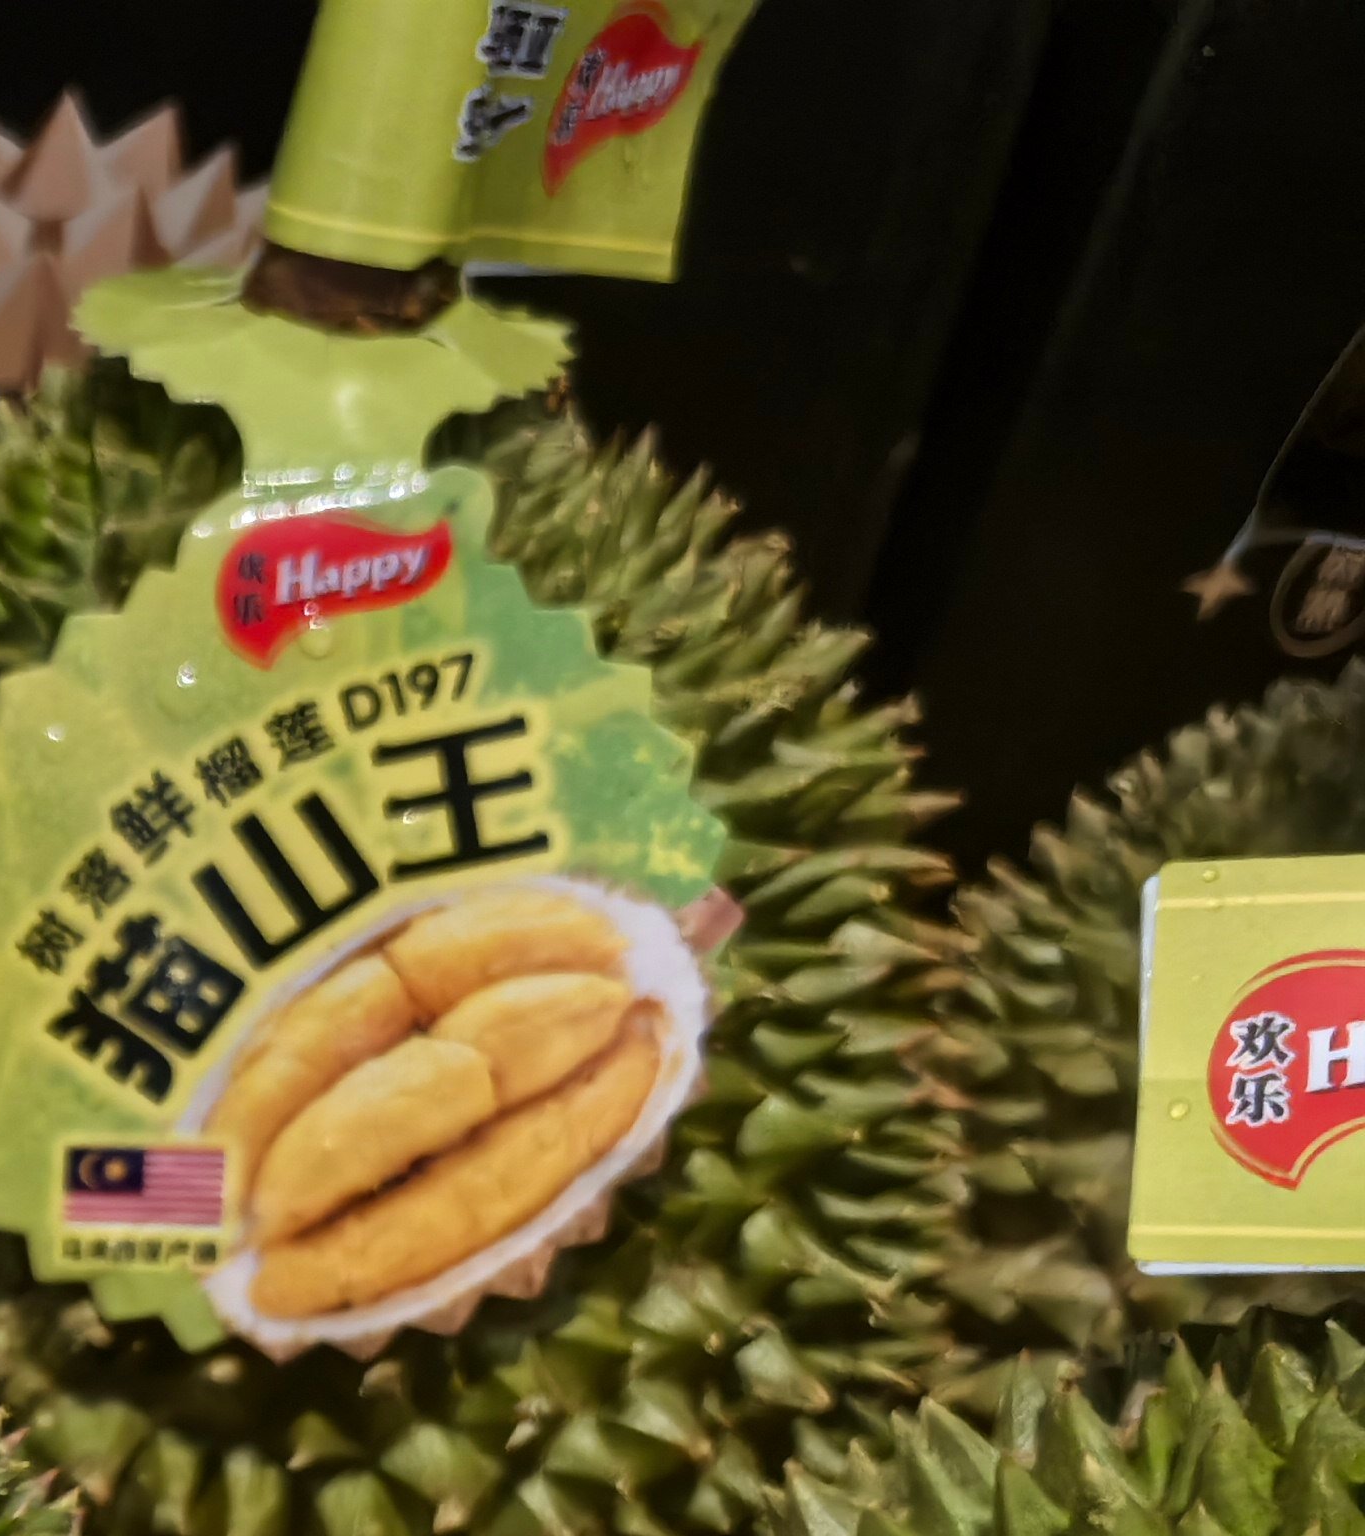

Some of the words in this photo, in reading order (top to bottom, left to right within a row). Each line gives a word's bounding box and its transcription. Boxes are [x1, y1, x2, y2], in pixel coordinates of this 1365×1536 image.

[273, 544, 432, 606] Happy
[44, 714, 550, 1104] 猫山王
[1234, 1016, 1291, 1124] 欢乐
